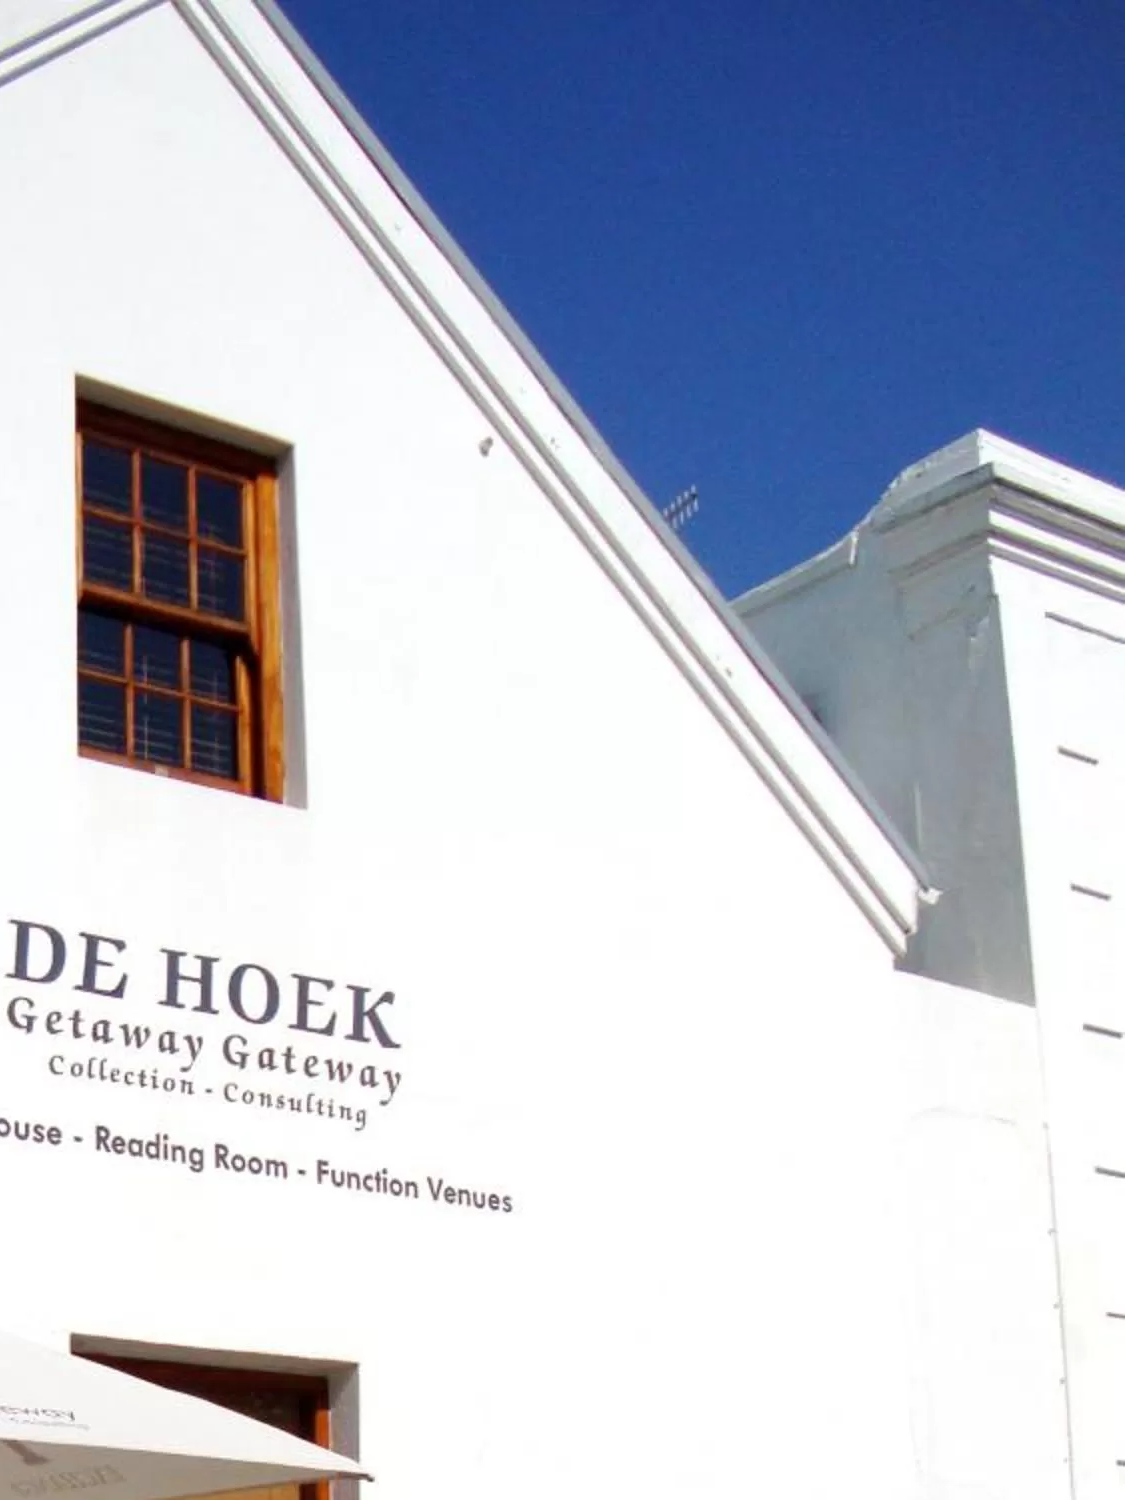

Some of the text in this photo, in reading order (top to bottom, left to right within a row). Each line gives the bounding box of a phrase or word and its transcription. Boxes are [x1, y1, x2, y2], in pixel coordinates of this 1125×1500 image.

[5, 919, 402, 1049] DE HOEK
[6, 996, 403, 1105] Getaway Gateway
[48, 1055, 194, 1096] Collection
[223, 1083, 367, 1131] Consulting
[95, 1125, 204, 1173] Reading
[214, 1143, 288, 1179] Room
[316, 1159, 419, 1199] Function
[426, 1176, 513, 1213] Venues
